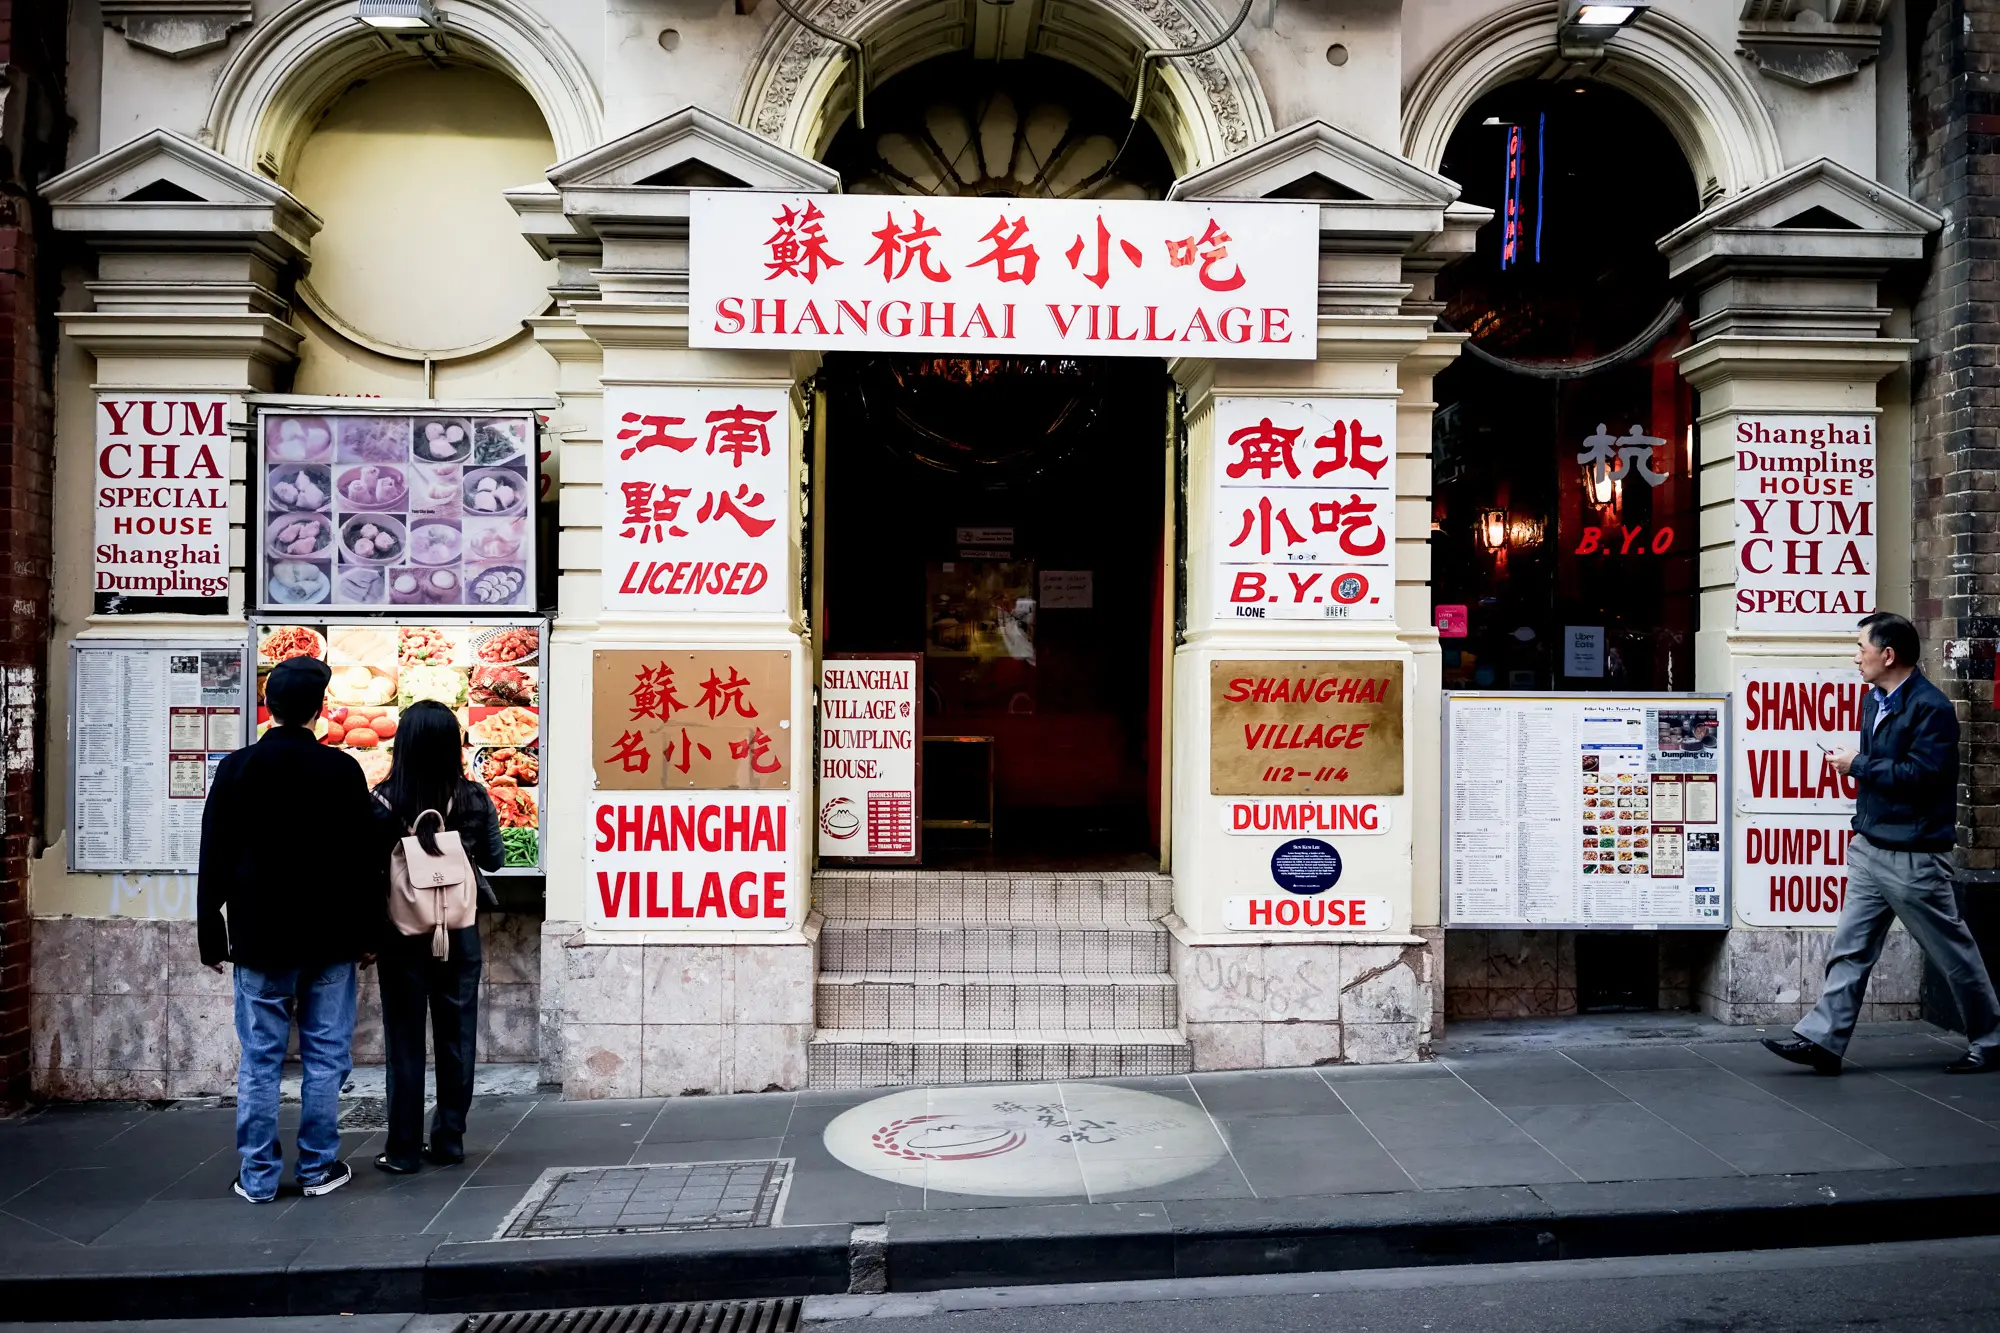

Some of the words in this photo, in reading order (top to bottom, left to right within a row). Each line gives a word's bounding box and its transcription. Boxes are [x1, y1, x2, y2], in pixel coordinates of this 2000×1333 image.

[764, 200, 1246, 292] 蘇杭名小吃
[714, 298, 1014, 338] SHANGHAI
[1047, 302, 1293, 344] VILLAGE
[99, 401, 228, 436] YUM
[617, 404, 776, 468] 江南
[1226, 418, 1388, 480] 南北
[1736, 422, 1872, 449] Shanghai
[99, 443, 224, 479] CHA
[1577, 422, 1669, 487] 杭
[1737, 451, 1875, 478] Dumpling
[99, 487, 228, 509] SPECIAL
[1760, 477, 1853, 496] HOUSE
[114, 517, 212, 535] HOUSE
[620, 482, 775, 544] 點心
[1230, 494, 1385, 556] 小吃
[1740, 499, 1874, 536] YUM
[1575, 526, 1675, 556] B.Y.O
[96, 544, 221, 569] Shanghai
[1741, 538, 1870, 575] CHA
[96, 570, 229, 596] Dumplings
[620, 562, 768, 595] LICENSED
[1230, 572, 1379, 604] B.Y.O.
[1736, 589, 1876, 614] SPECIAL
[1574, 632, 1595, 640] Uber
[626, 659, 760, 725] 蘇杭
[824, 670, 908, 690] SHANGHAI
[1224, 677, 1390, 704] SHANGHAI
[824, 700, 896, 720] VILLAGE
[1747, 681, 1869, 731] SHANGHA
[603, 727, 782, 776] 名小吃
[824, 730, 912, 749] DUMPLING
[1244, 723, 1369, 750] VILLAGE
[824, 760, 876, 778] HOUSE
[1661, 751, 1699, 760] Dumpling
[1700, 751, 1714, 760] city
[1263, 766, 1349, 782] 112-114
[596, 804, 786, 852] SHANGHAI
[1233, 804, 1378, 830] DUMPLING
[1747, 828, 1854, 864] DUMPLI
[597, 871, 786, 919] VILLAGE
[1250, 900, 1366, 926] HOUSE
